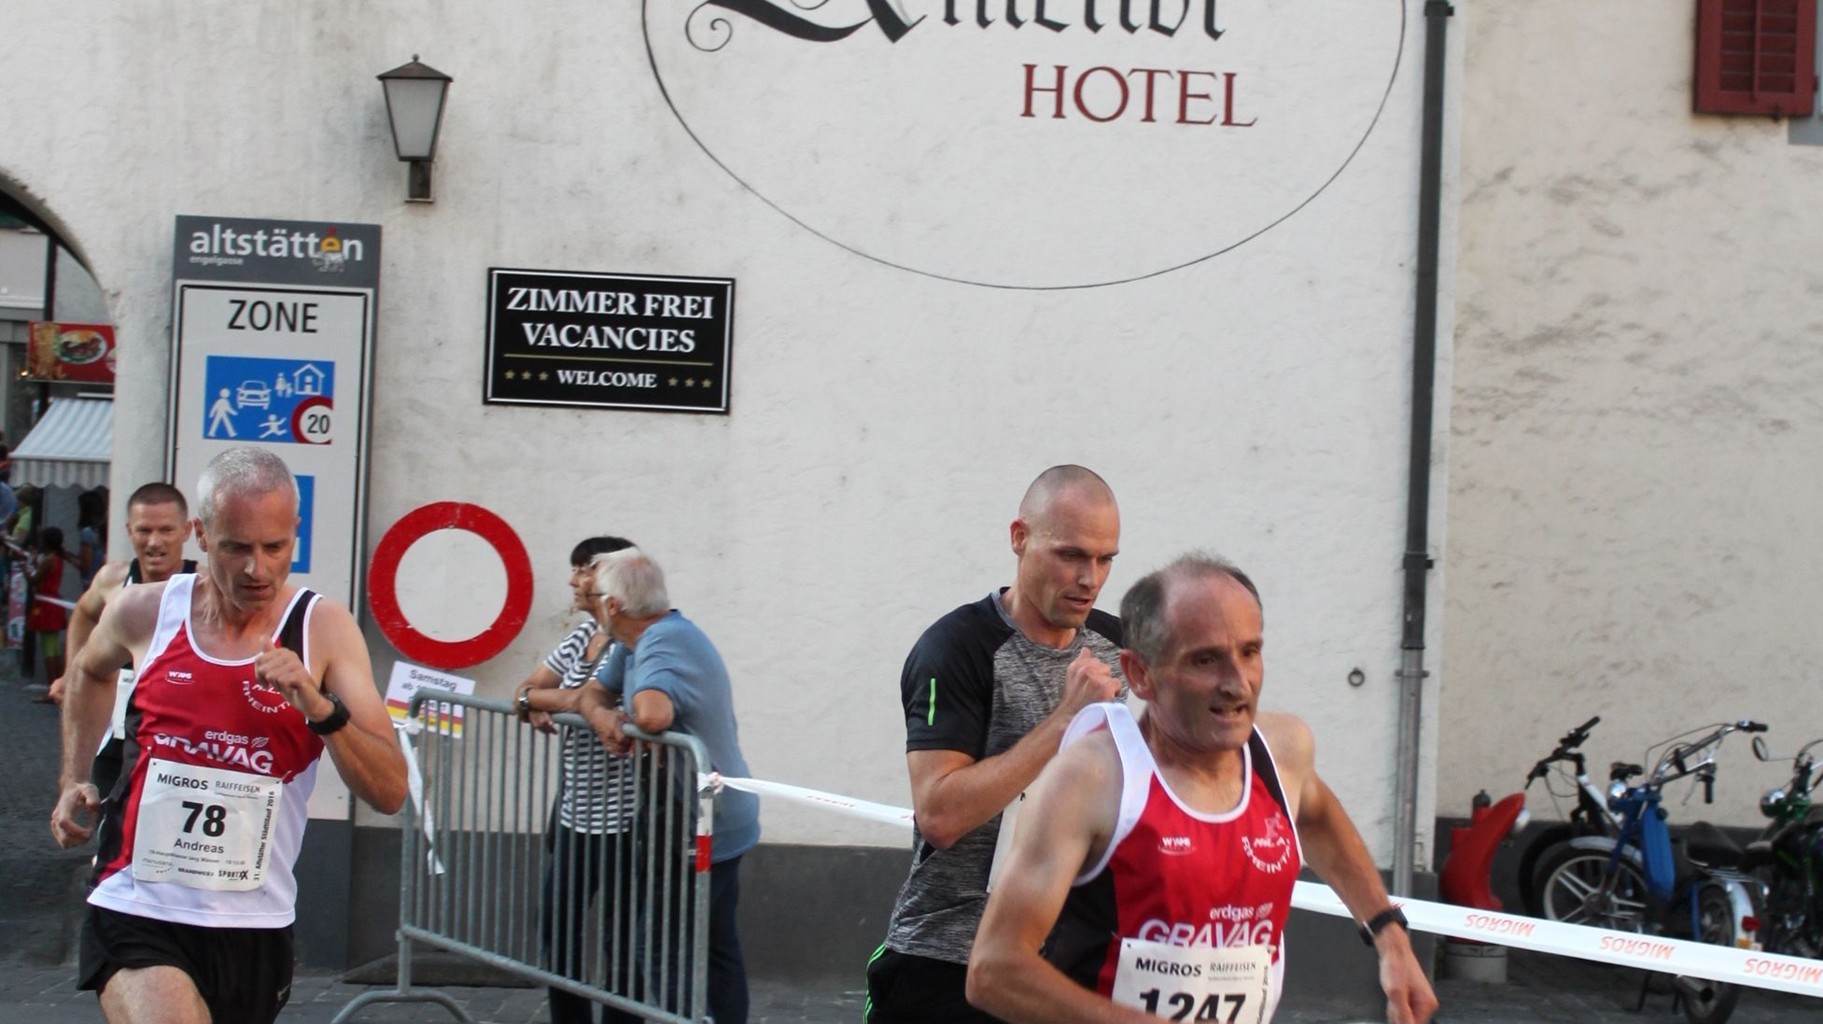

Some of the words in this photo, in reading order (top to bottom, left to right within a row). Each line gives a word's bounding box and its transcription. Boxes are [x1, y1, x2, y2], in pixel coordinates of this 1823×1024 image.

[1019, 62, 1258, 126] HOTEL
[189, 224, 363, 261] altstätten
[506, 286, 638, 316] ZIMMER
[643, 293, 715, 319] FREI
[228, 299, 319, 333] ZONE
[521, 322, 696, 353] VACANCIES
[557, 369, 658, 388] WELCOME
[307, 414, 331, 434] 20
[409, 669, 458, 692] Samstag
[204, 730, 249, 745] erdgas
[156, 773, 209, 791] MIGROS
[215, 780, 261, 793] RAIFFEISEN
[181, 801, 227, 837] 78
[173, 838, 225, 855] Andreas
[1209, 904, 1255, 921] erdgas
[1138, 918, 1274, 949] GRAVAG
[1464, 913, 1536, 938] MIGROS
[1600, 935, 1675, 961] MIGROS
[1135, 957, 1202, 977] MIGROS
[1743, 957, 1823, 984] MIGROS
